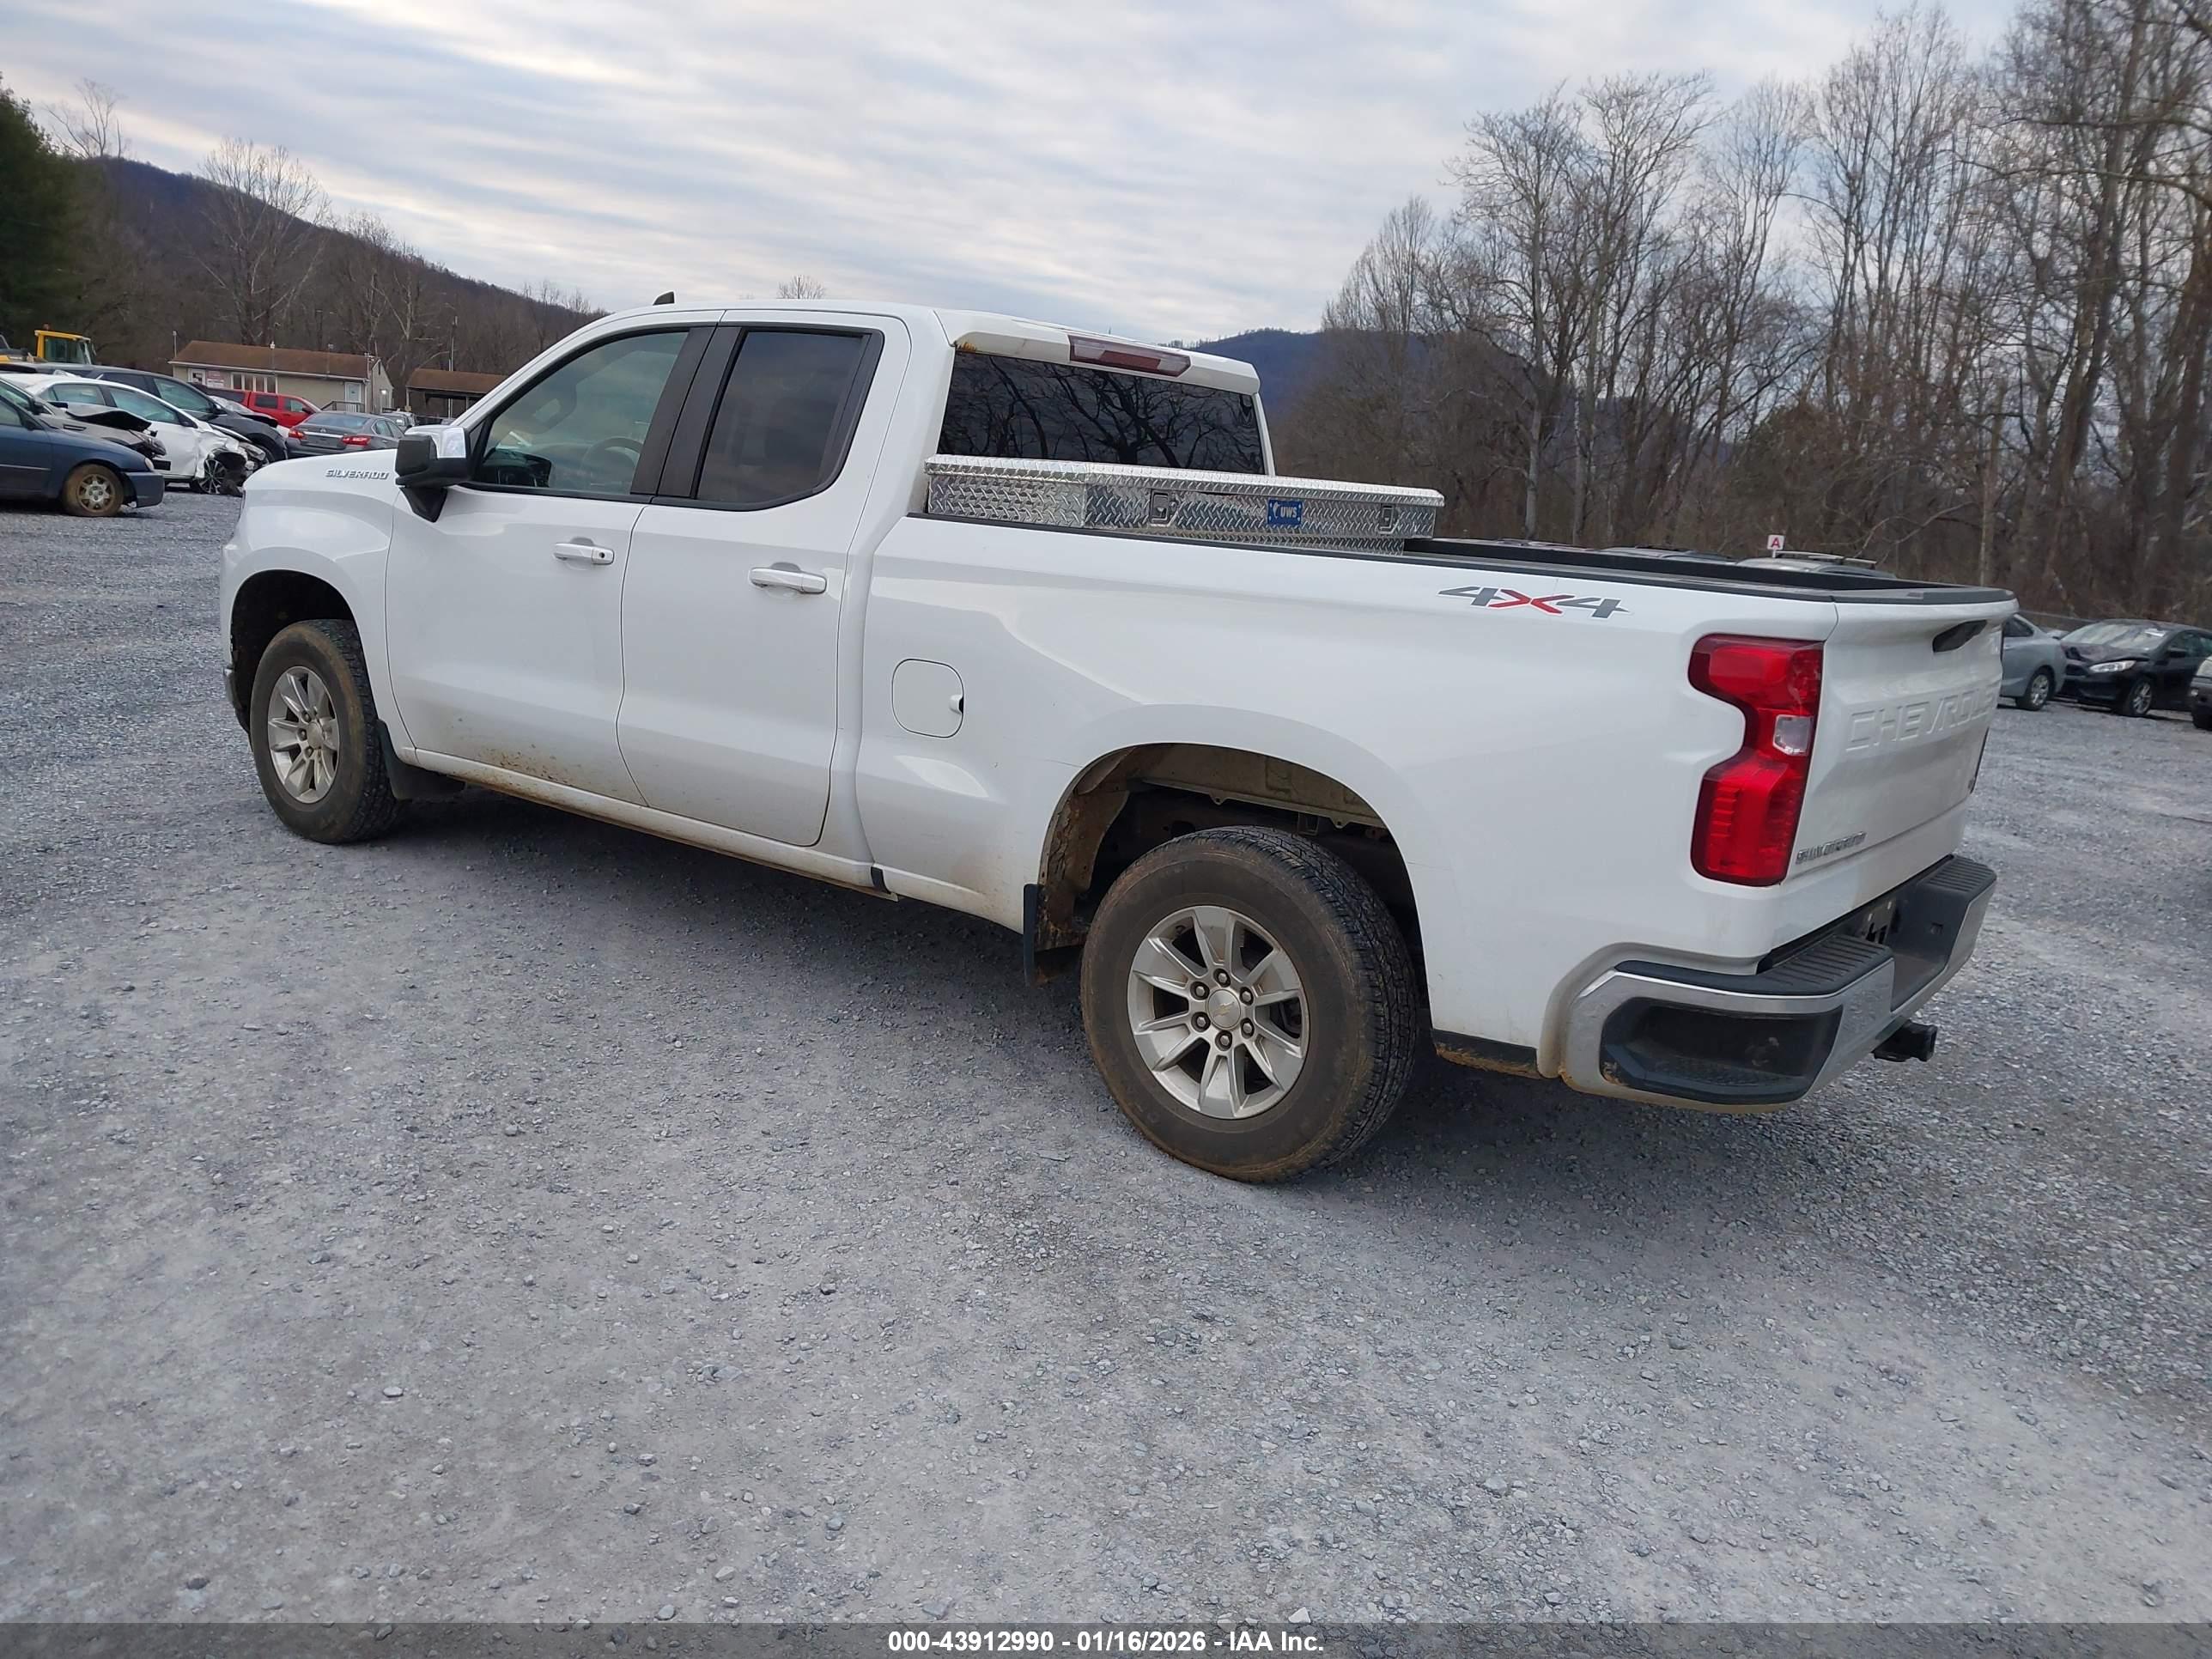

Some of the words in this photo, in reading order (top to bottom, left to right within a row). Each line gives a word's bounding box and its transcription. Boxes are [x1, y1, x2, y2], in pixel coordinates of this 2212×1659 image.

[325, 469, 390, 480] SILVERADO
[1280, 507, 1297, 518] UWS
[1771, 537, 1780, 549] A
